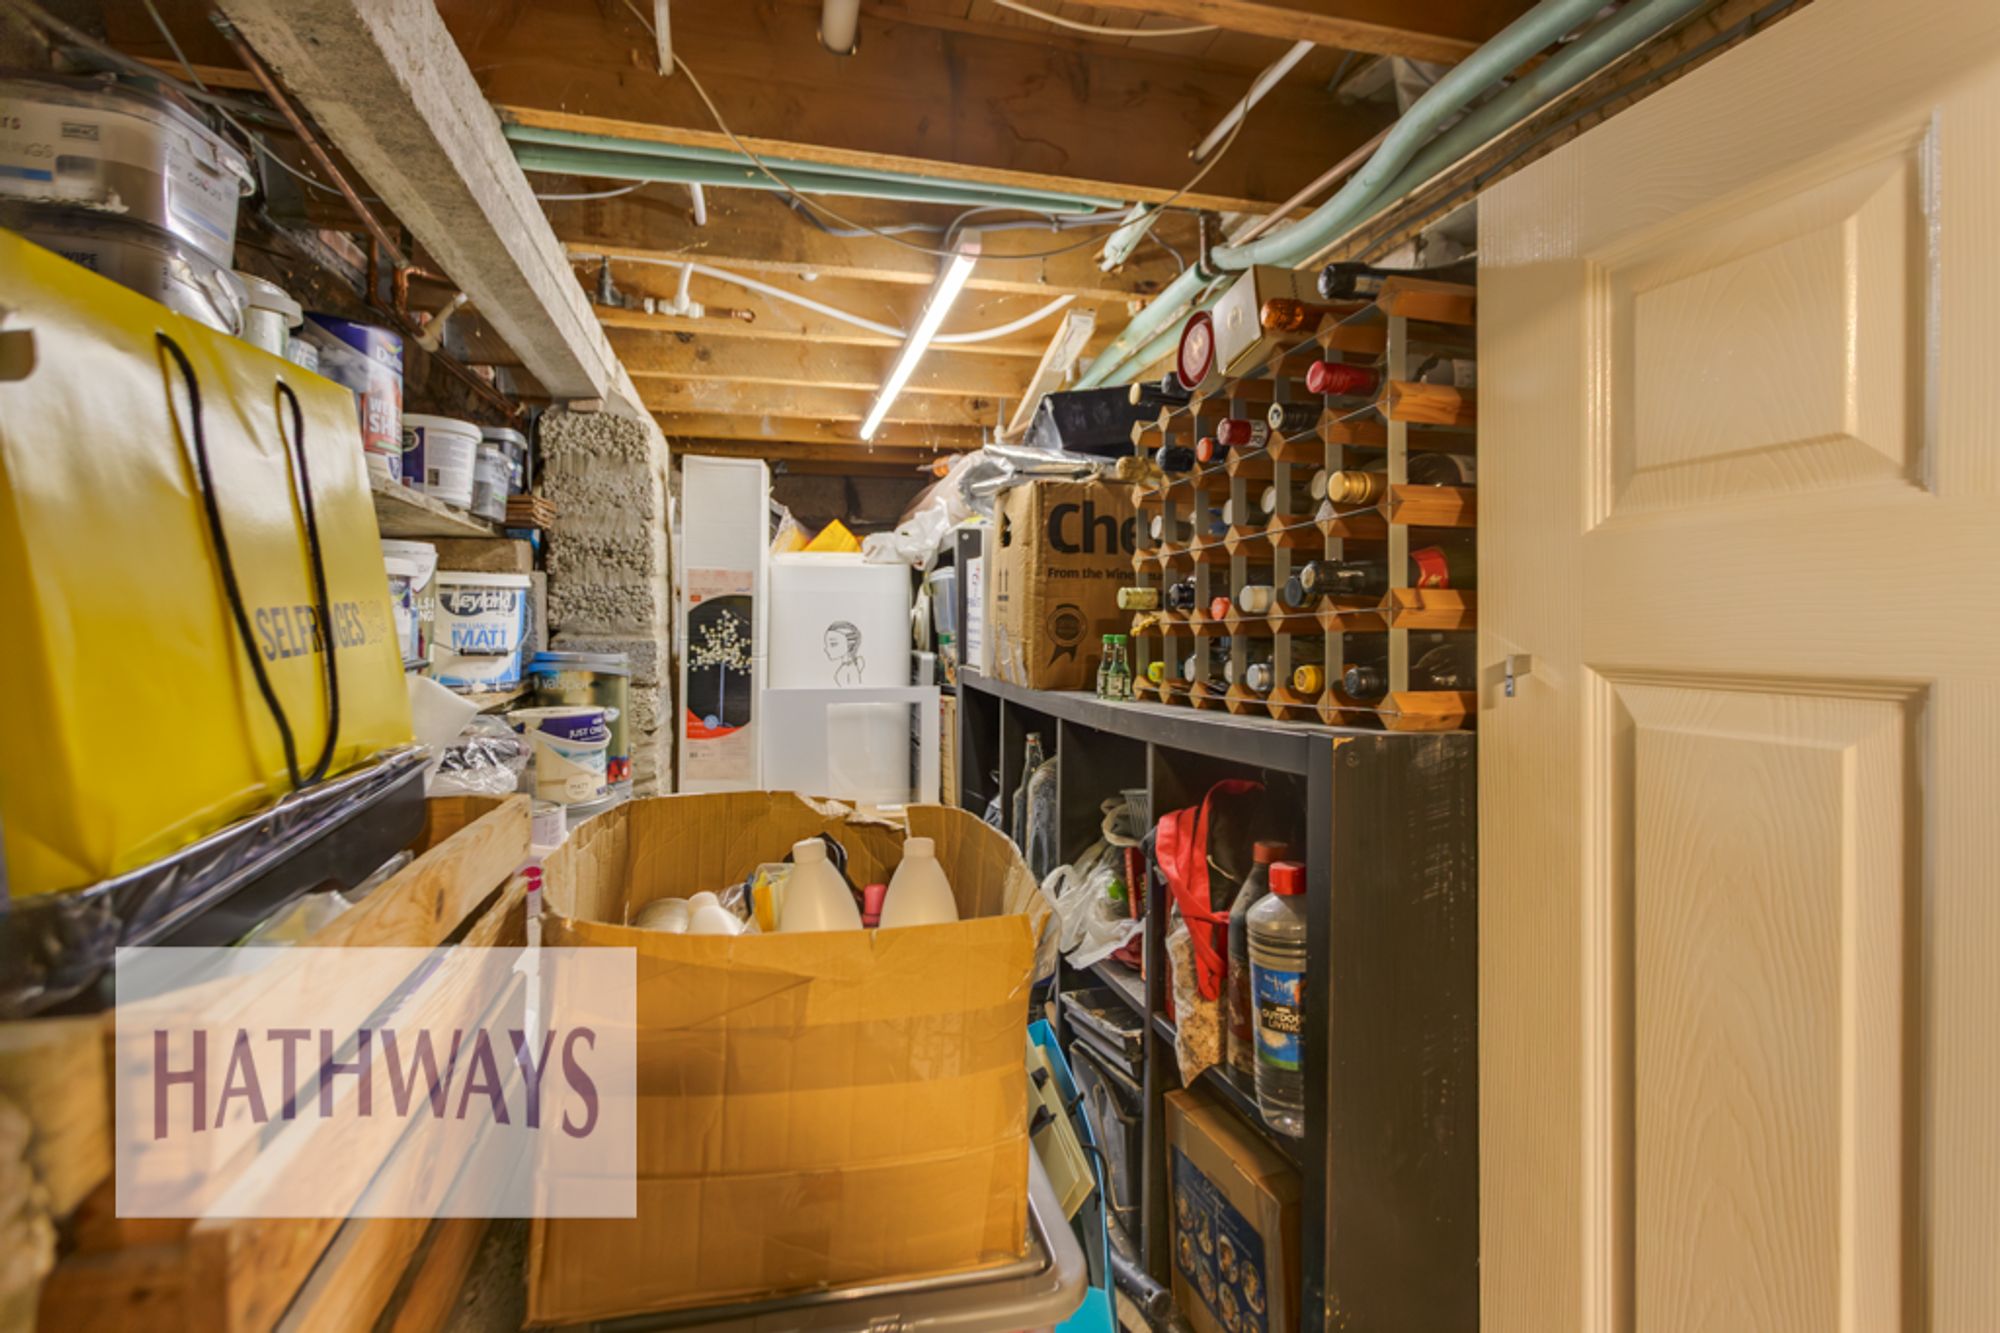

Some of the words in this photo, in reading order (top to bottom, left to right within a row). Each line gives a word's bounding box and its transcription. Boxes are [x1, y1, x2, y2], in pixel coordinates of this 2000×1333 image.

[1047, 567, 1079, 579] From
[1082, 567, 1104, 579] the
[255, 602, 366, 662] SELFRGES
